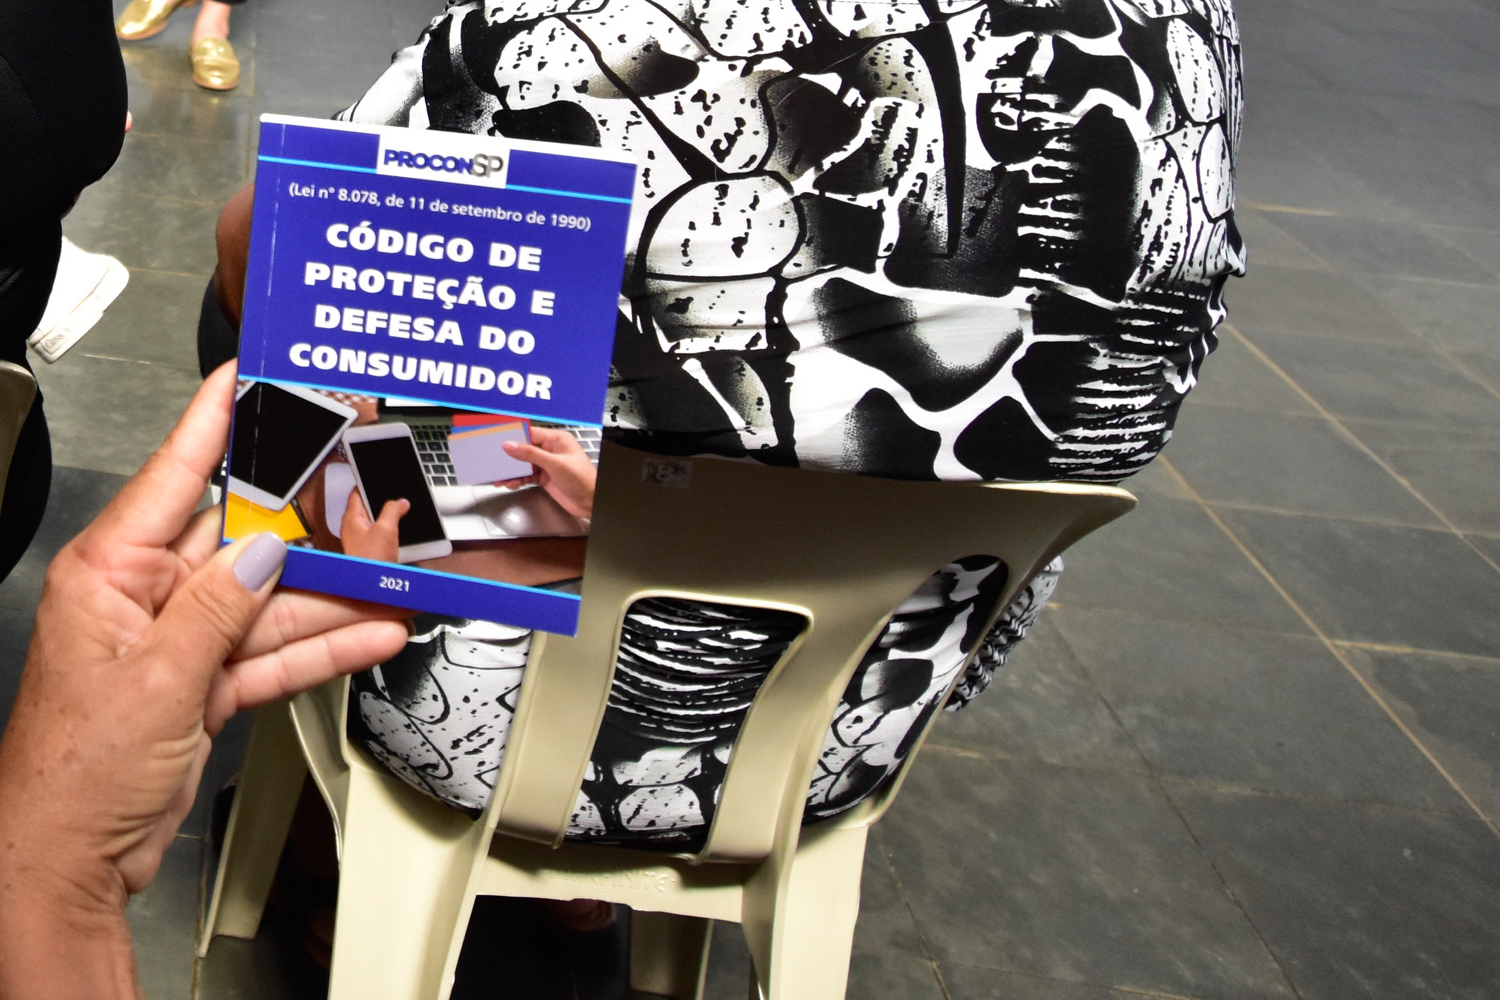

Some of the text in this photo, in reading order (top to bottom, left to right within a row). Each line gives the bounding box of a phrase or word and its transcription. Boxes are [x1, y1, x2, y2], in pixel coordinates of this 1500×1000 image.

[289, 182, 315, 197] (Lei
[338, 188, 380, 206] 8.078,
[385, 194, 404, 207] de
[410, 197, 424, 209] 11
[430, 199, 448, 212] de
[452, 205, 522, 221] setembro
[526, 211, 545, 224] de
[552, 214, 591, 232] 1990)
[326, 221, 542, 271] CÓDIGO DE
[304, 261, 555, 315] PROTEÇÃO E
[314, 303, 535, 354] DEFESA DO
[288, 342, 553, 400] CONSUMIDOR
[380, 576, 410, 592] 2021
